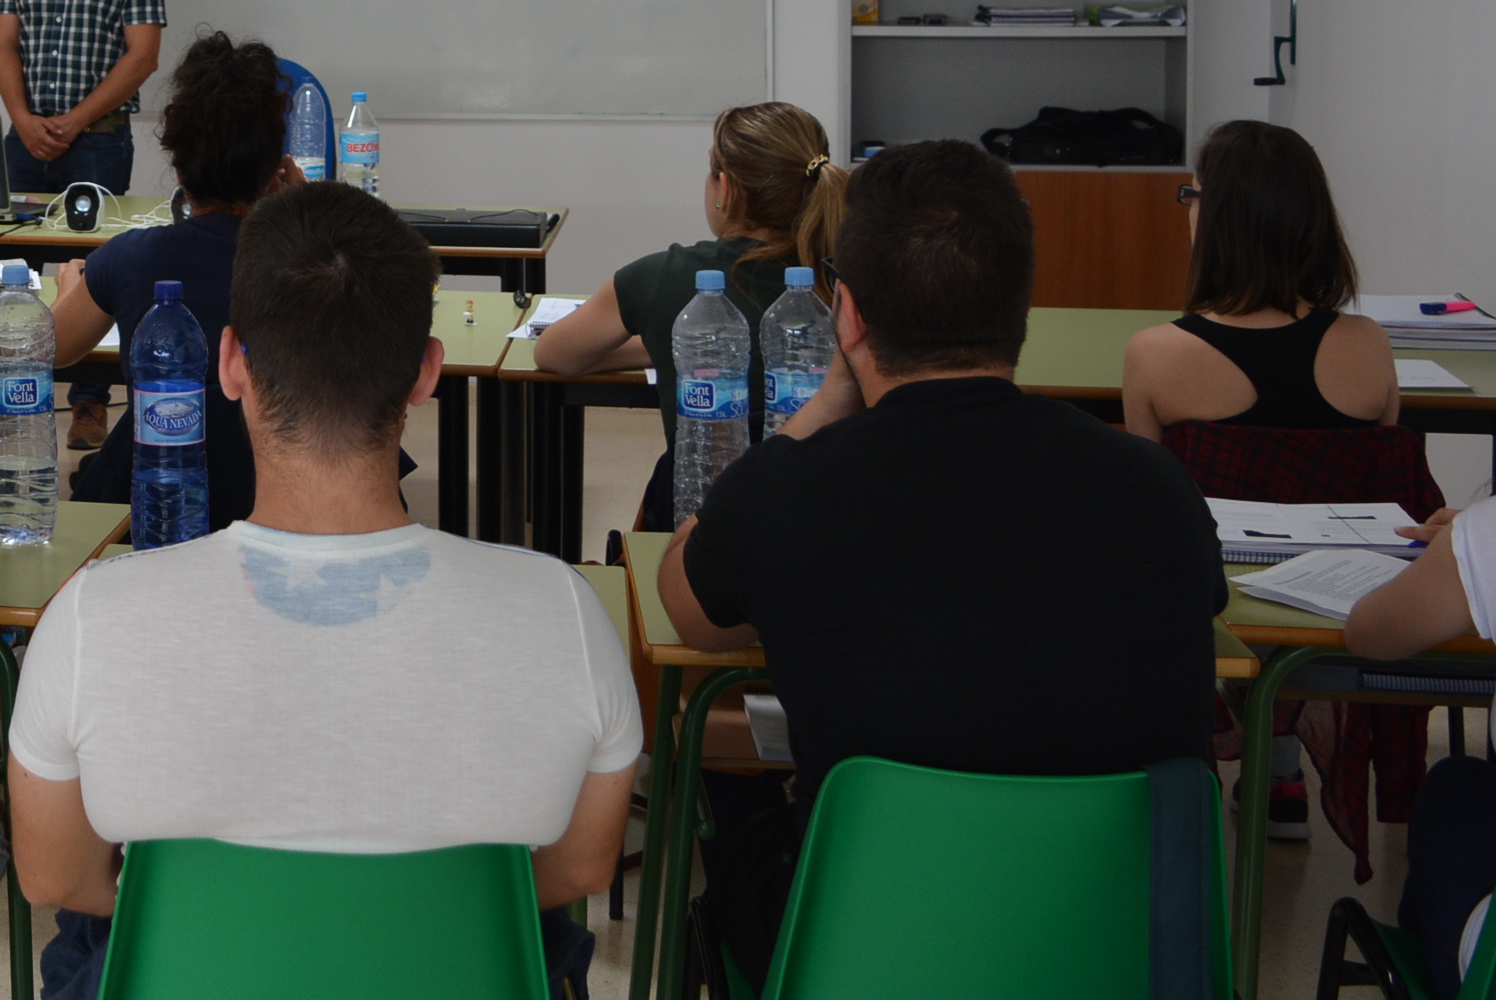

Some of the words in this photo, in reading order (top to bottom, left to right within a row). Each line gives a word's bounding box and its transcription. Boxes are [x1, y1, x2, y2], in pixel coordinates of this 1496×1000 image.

[7, 380, 34, 392] Font
[684, 382, 710, 396] Font
[7, 391, 35, 404] Vella
[684, 394, 711, 407] Vella
[143, 410, 168, 429] AQUA
[169, 409, 203, 429] NEVADA
